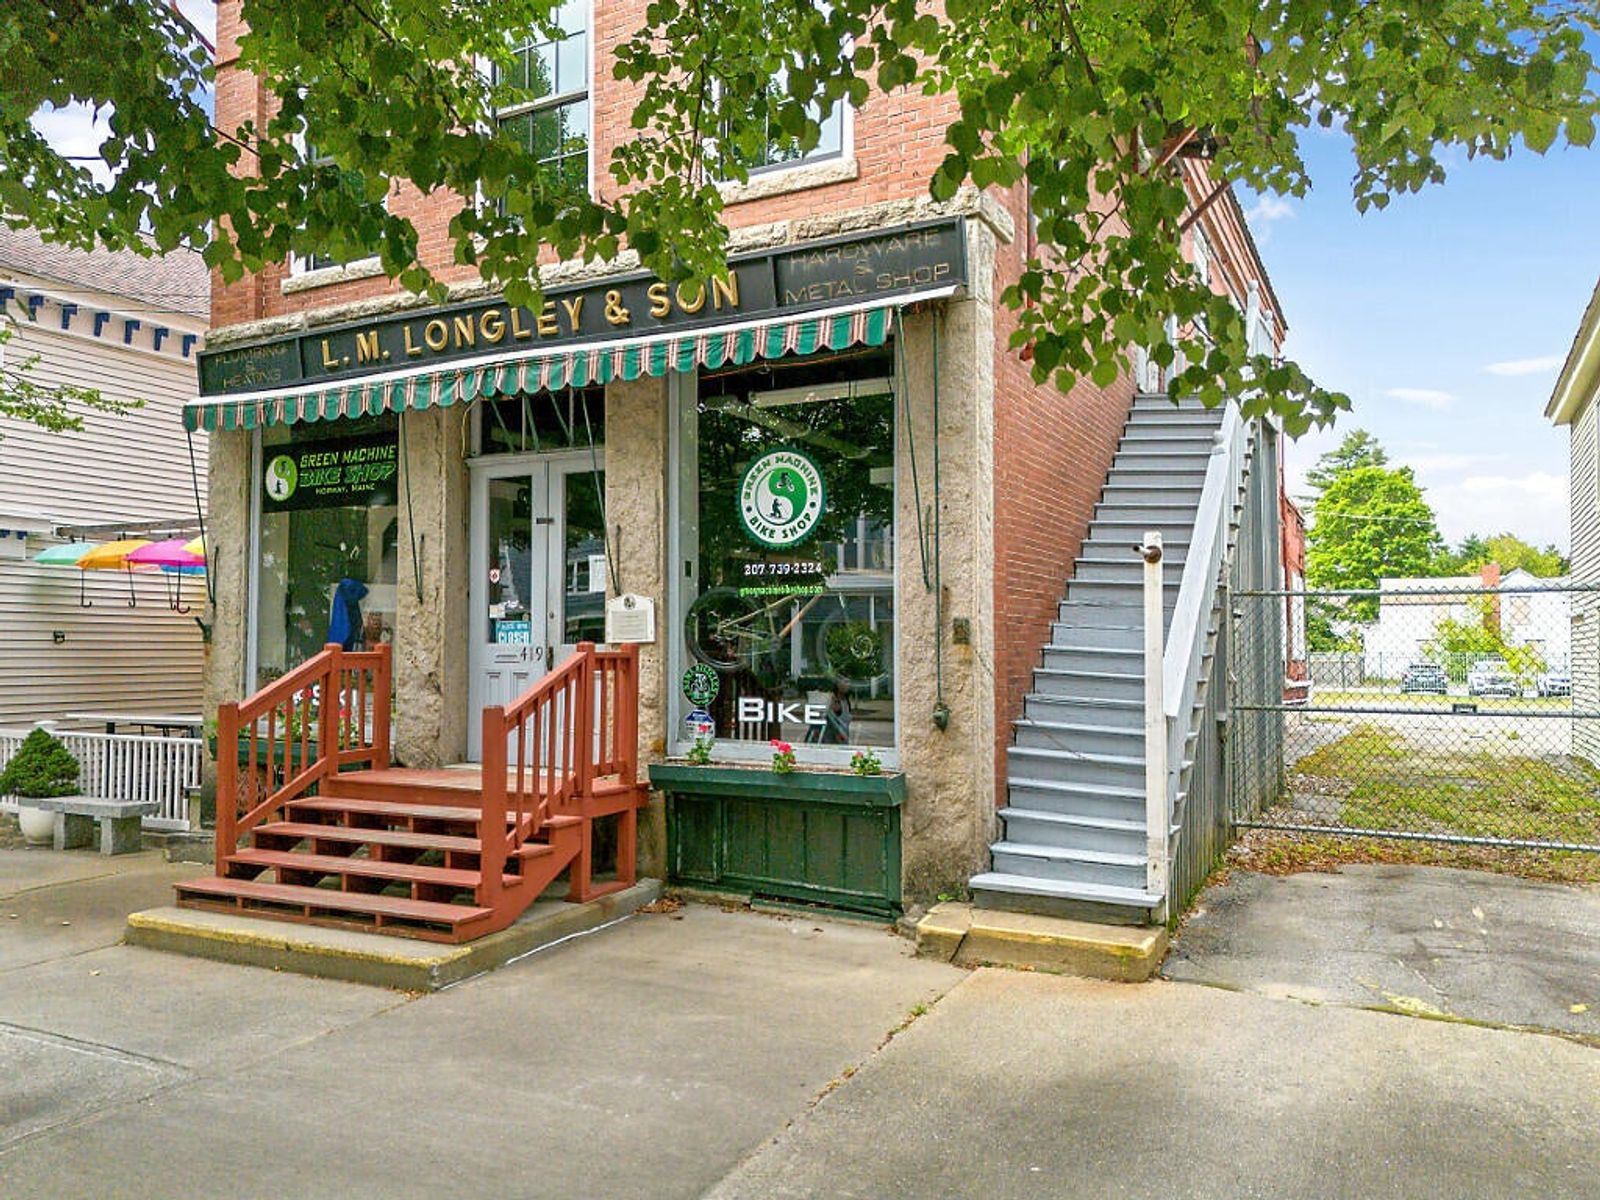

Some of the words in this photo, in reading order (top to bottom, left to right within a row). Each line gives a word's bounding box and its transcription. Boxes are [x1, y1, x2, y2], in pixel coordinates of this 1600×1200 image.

[785, 280, 866, 304] METAL
[876, 263, 950, 290] SHOP
[321, 339, 350, 368] L.
[356, 330, 390, 363] M.
[404, 296, 584, 356] LONGLEY
[604, 289, 630, 325] &
[647, 270, 739, 319] SON
[299, 467, 342, 487] BIKE
[343, 460, 396, 484] SHOP
[300, 452, 340, 469] GREEN
[341, 444, 397, 463] MACHINE
[743, 459, 771, 500] GREEN
[775, 456, 818, 496] MACHINE
[749, 515, 776, 539] BIKE
[782, 512, 811, 539] SHOP
